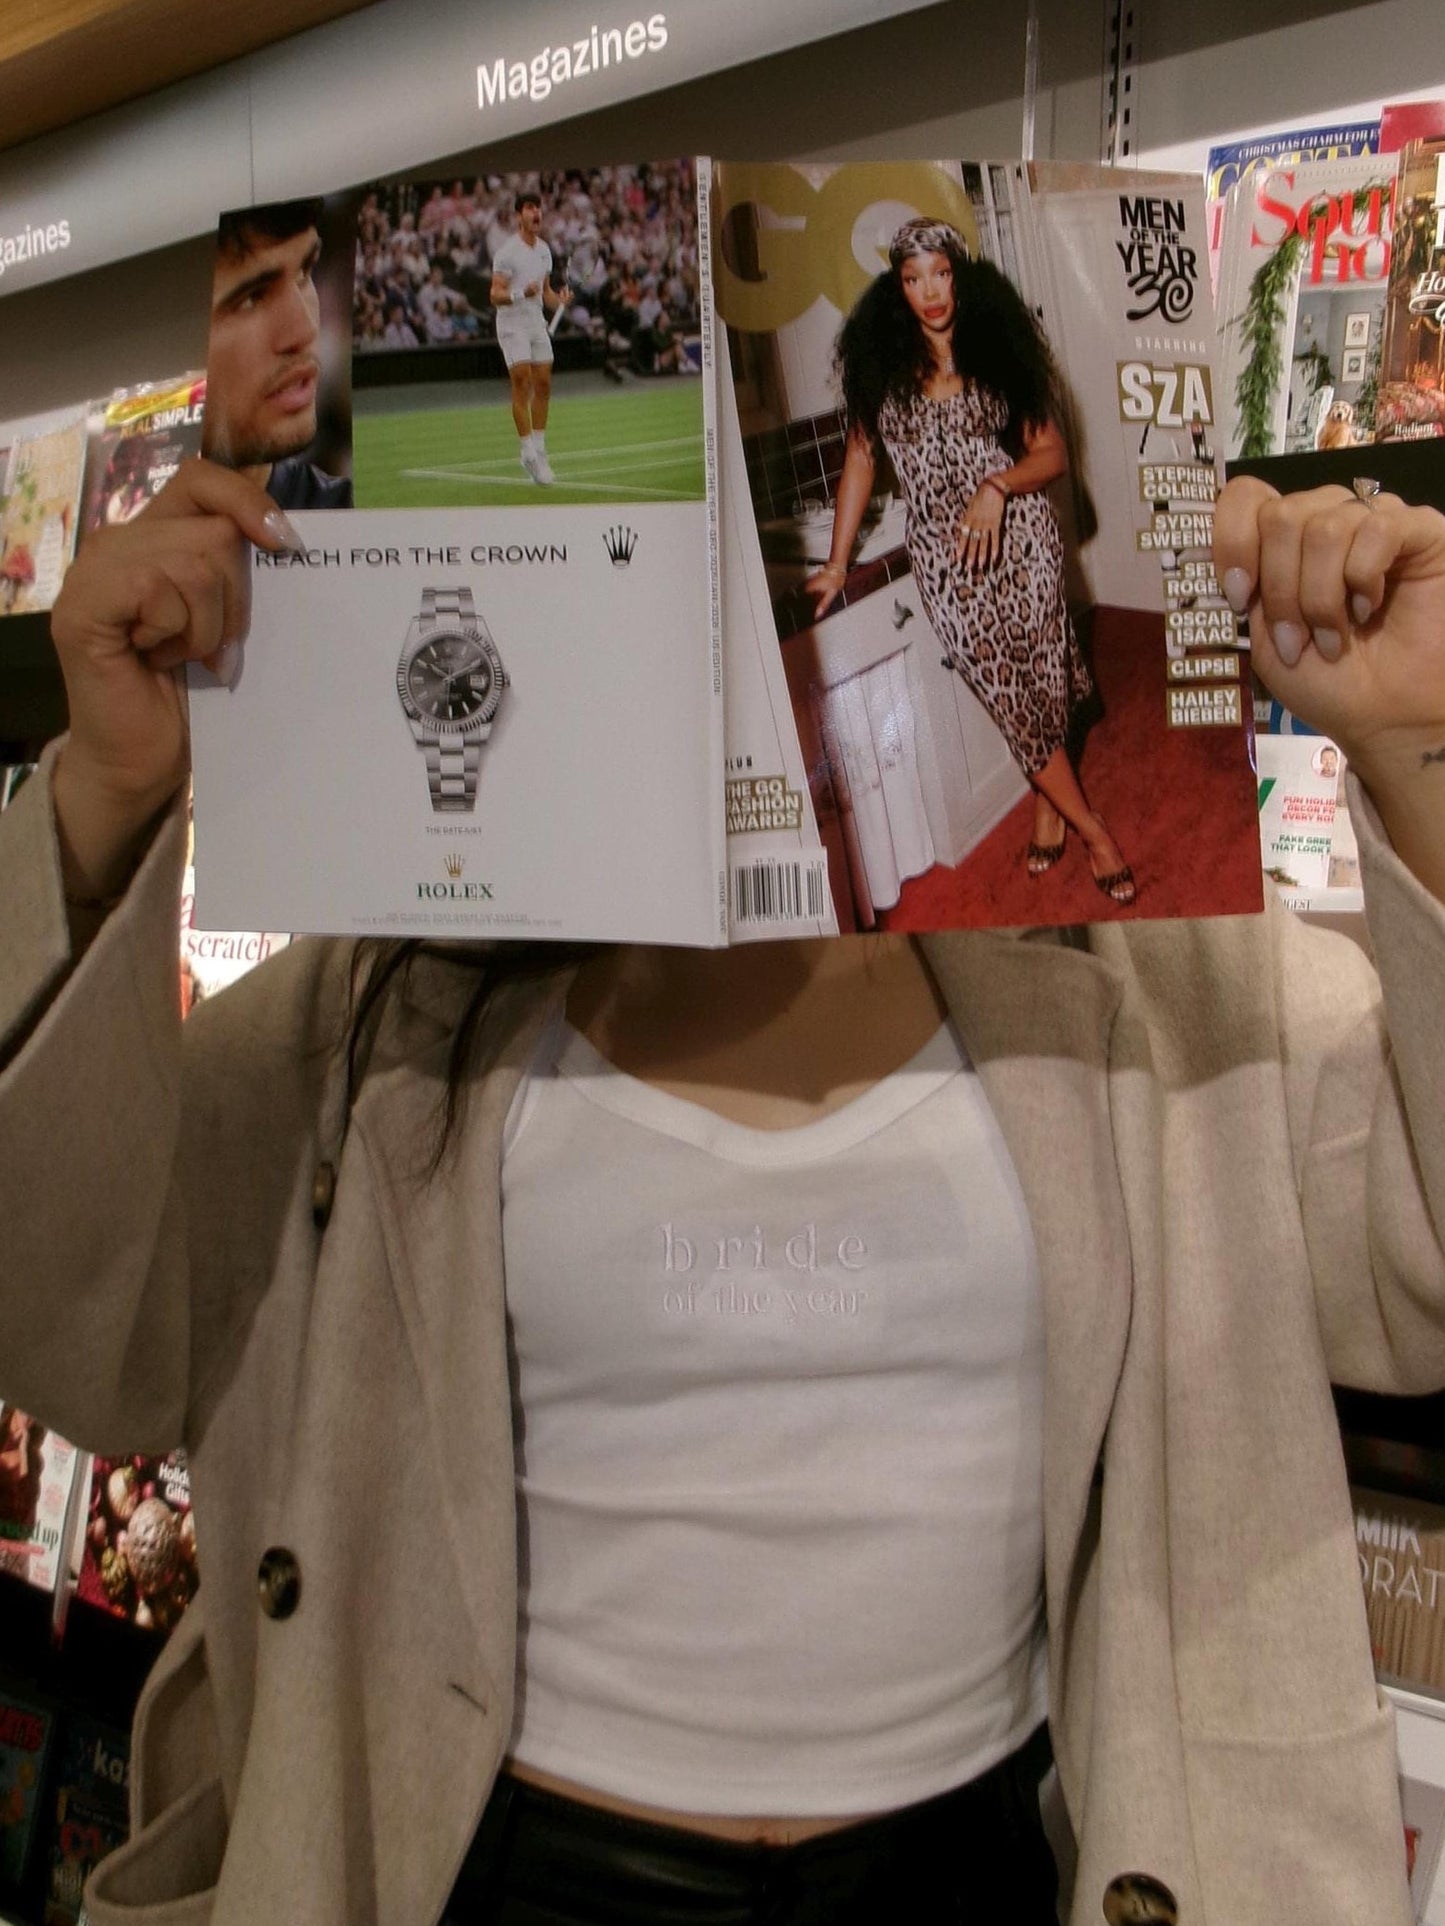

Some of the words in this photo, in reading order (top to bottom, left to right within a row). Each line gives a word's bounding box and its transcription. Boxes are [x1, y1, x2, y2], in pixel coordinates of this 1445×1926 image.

[477, 13, 668, 109] Magazines
[1119, 195, 1186, 231] MEN
[711, 160, 980, 333] GQ
[1130, 228, 1150, 242] OF
[1152, 231, 1180, 245] THE
[1116, 240, 1198, 278] YEAR
[1120, 361, 1212, 428] SZA
[152, 403, 205, 430] SIMPLE
[1143, 466, 1215, 485] STEPHEN
[1144, 482, 1216, 501] COLBERT
[255, 547, 340, 570] REACH
[350, 547, 401, 567] FOR
[408, 546, 461, 566] THE
[470, 544, 568, 564] CROWN
[1167, 578, 1222, 598] ROGE
[1169, 610, 1233, 628] OSCAR
[1176, 626, 1233, 645] ISAAC
[1171, 657, 1236, 678] CLIPSE
[1171, 689, 1237, 709] HAILEY
[1171, 706, 1237, 726] BIEBER
[416, 882, 495, 900] ROLEX
[660, 1221, 868, 1273] bride
[663, 1281, 698, 1315] of
[713, 1283, 770, 1315] the
[784, 1289, 868, 1328] year
